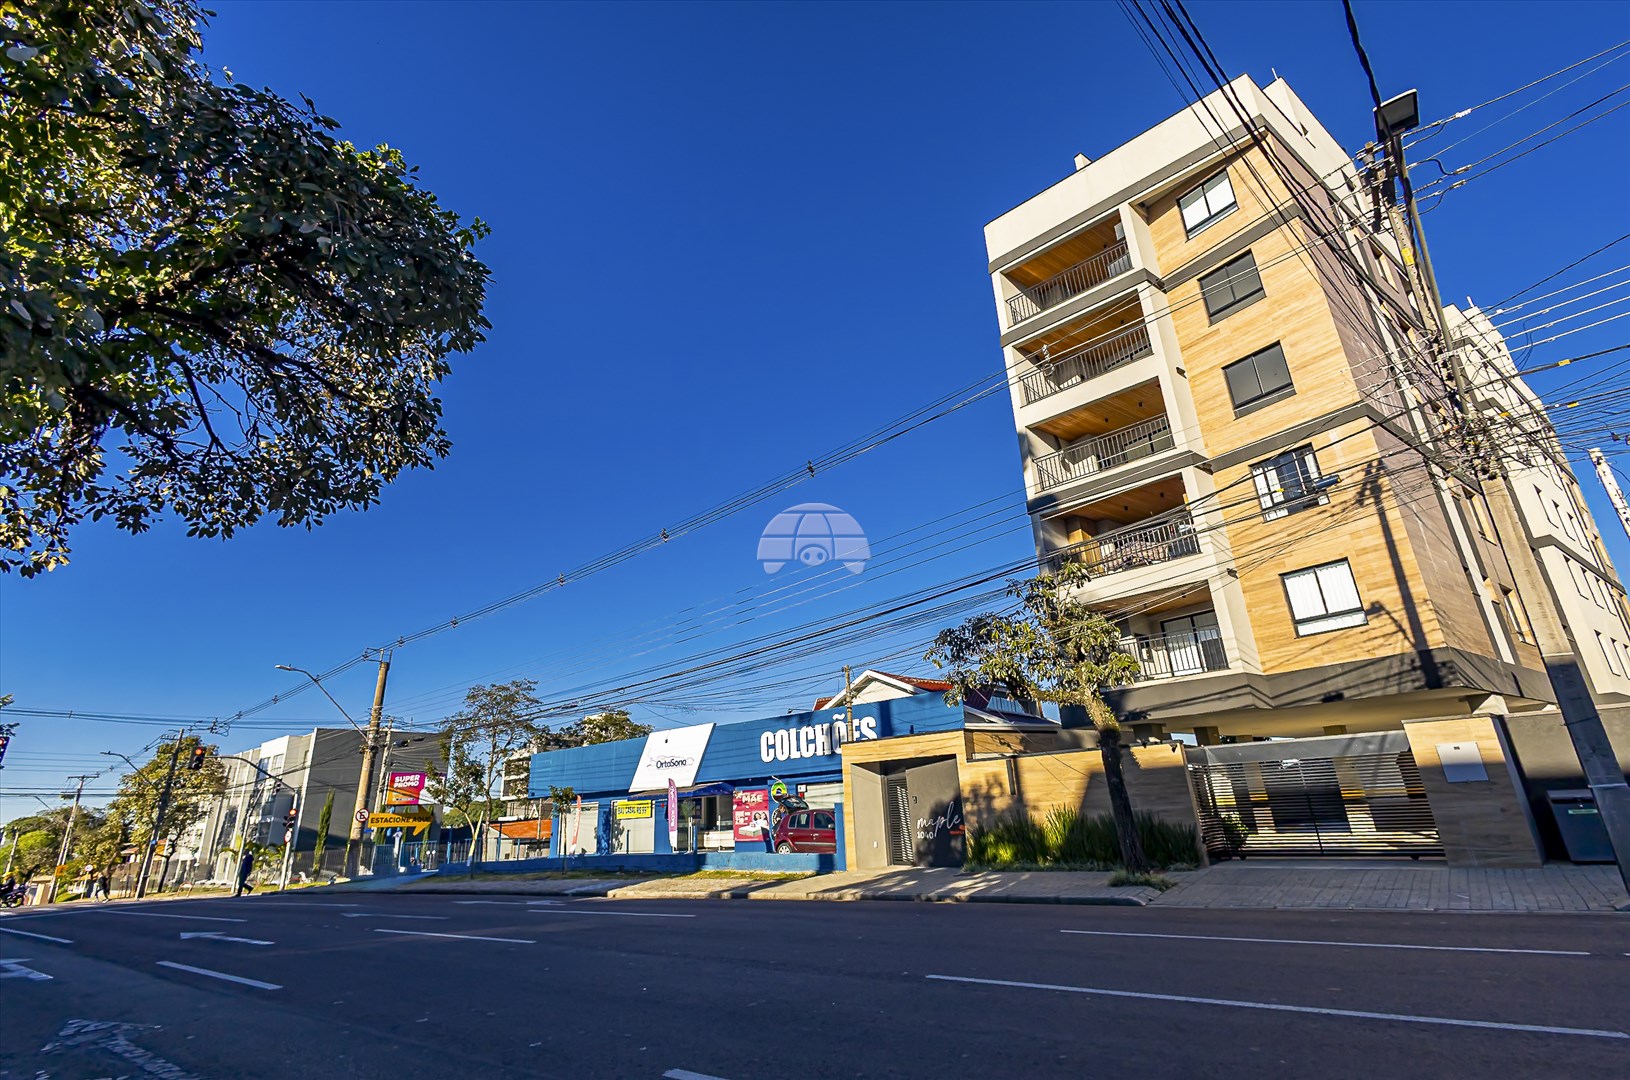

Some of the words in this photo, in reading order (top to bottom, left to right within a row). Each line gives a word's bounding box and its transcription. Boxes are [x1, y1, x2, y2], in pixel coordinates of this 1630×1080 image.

[656, 758, 687, 768] OrtoSono
[394, 774, 420, 783] SUPER
[393, 780, 419, 788] PROMO
[370, 816, 410, 824] ESTACIONE
[917, 801, 961, 837] maple
[916, 831, 934, 839] 1040
